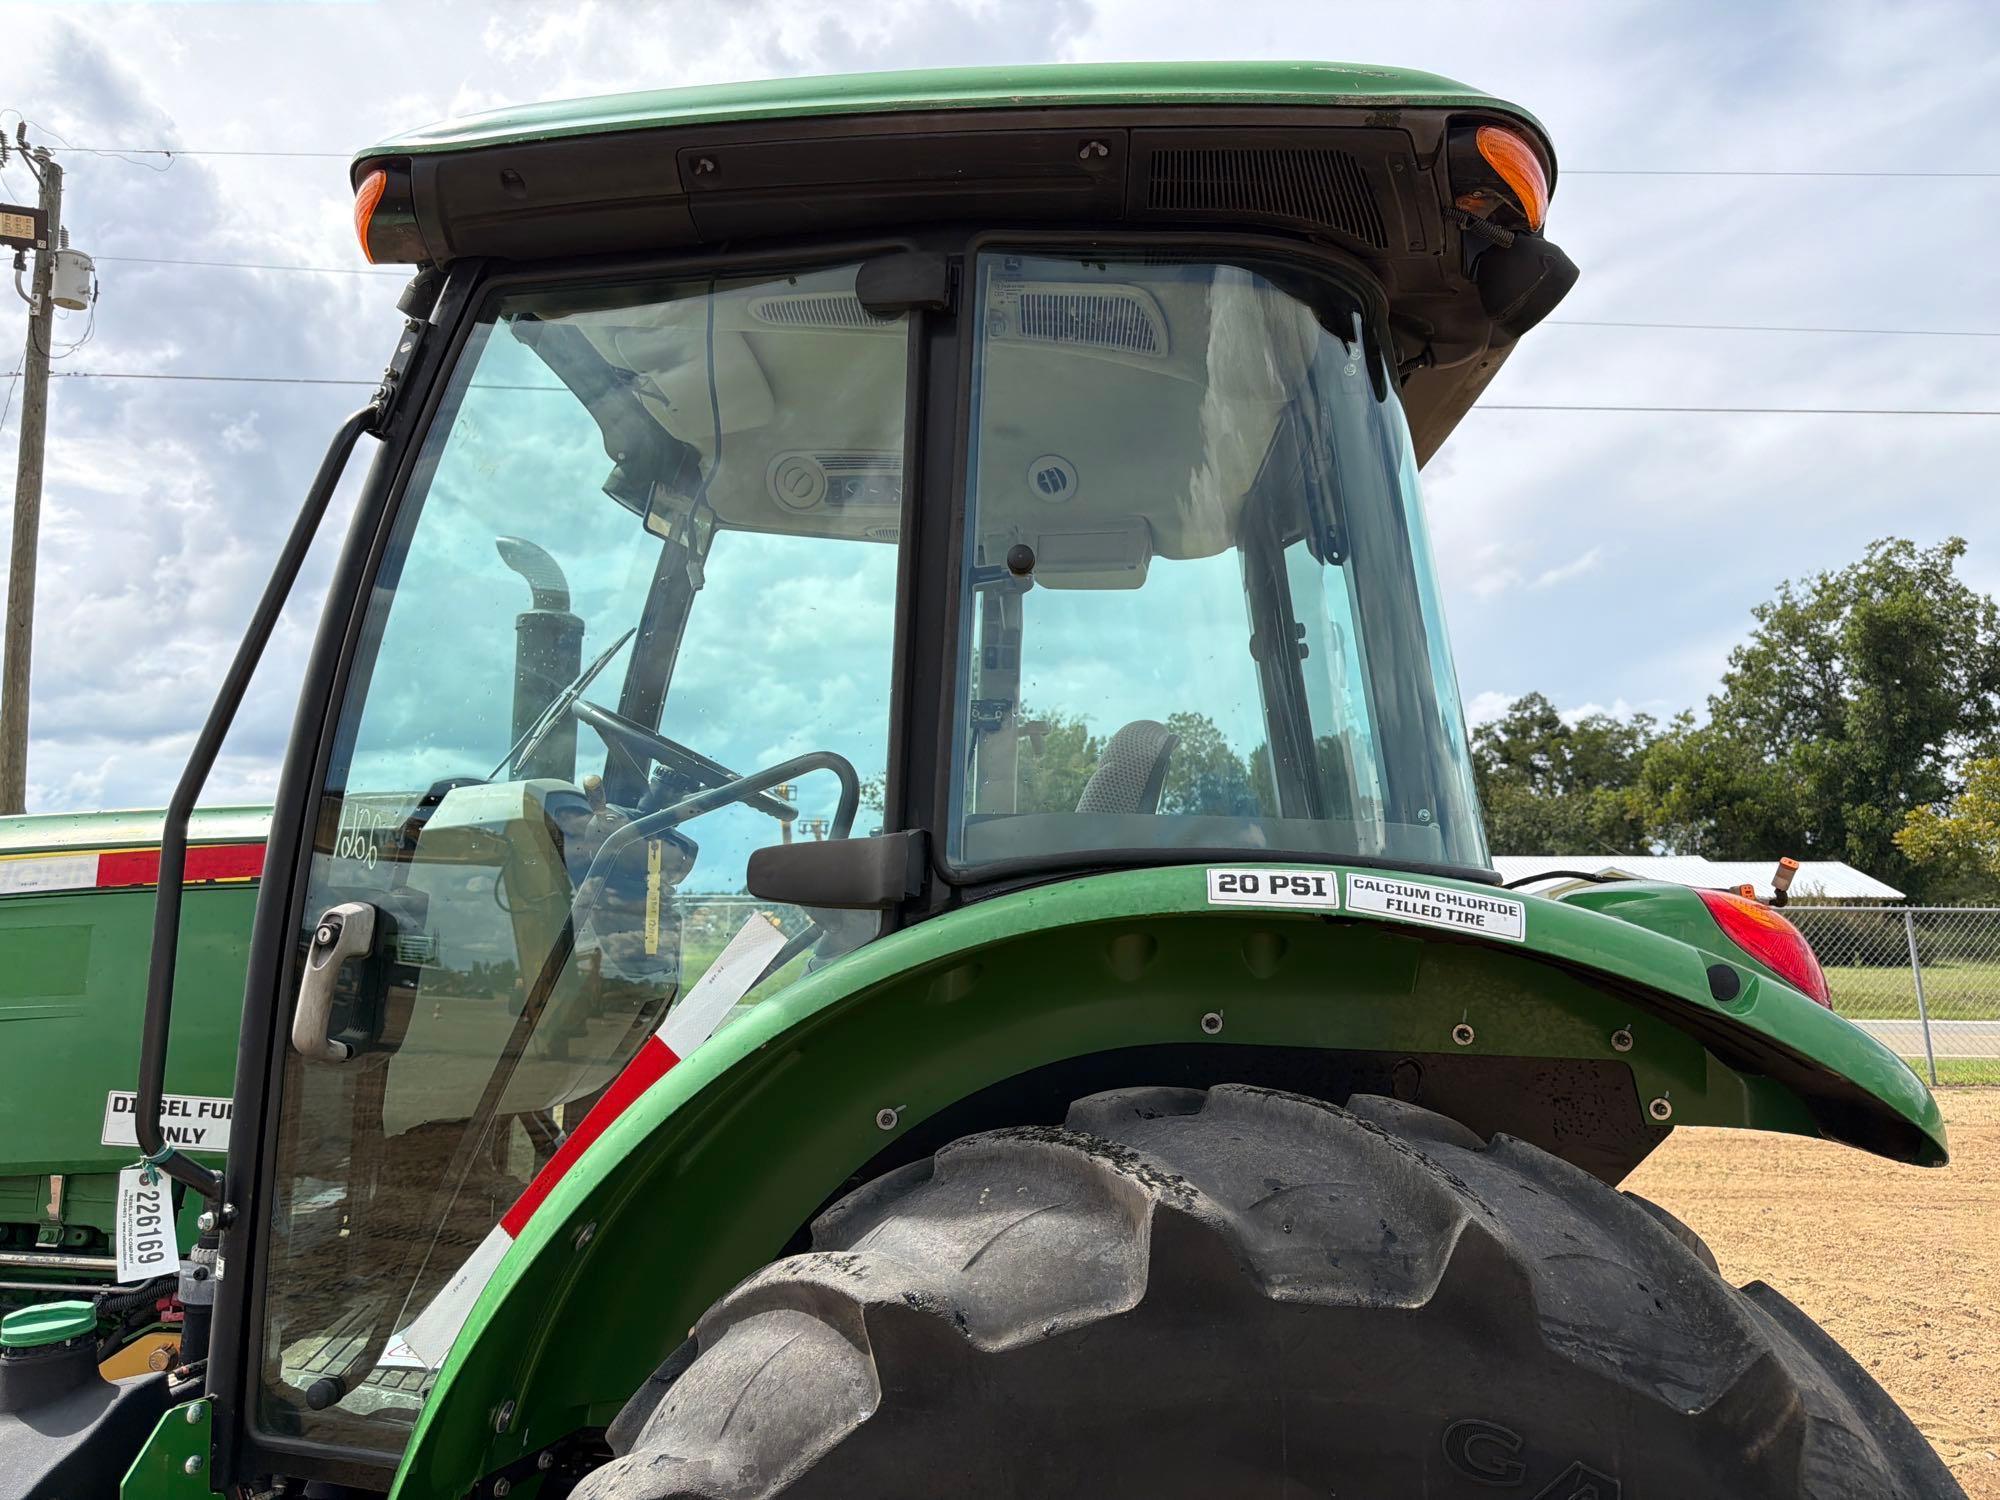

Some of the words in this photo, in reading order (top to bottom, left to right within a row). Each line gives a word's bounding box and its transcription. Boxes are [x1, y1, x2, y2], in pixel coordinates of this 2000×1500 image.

[1218, 873, 1259, 894] 20
[1270, 874, 1327, 897] PSI
[1353, 879, 1431, 900] CALCIUM
[1435, 892, 1518, 917] CHLORIDE
[1385, 898, 1442, 918] FILLED
[1446, 909, 1485, 927] TIRE
[112, 1096, 192, 1117] DISEL
[198, 1102, 233, 1119] FU
[136, 1190, 165, 1264] 226169
